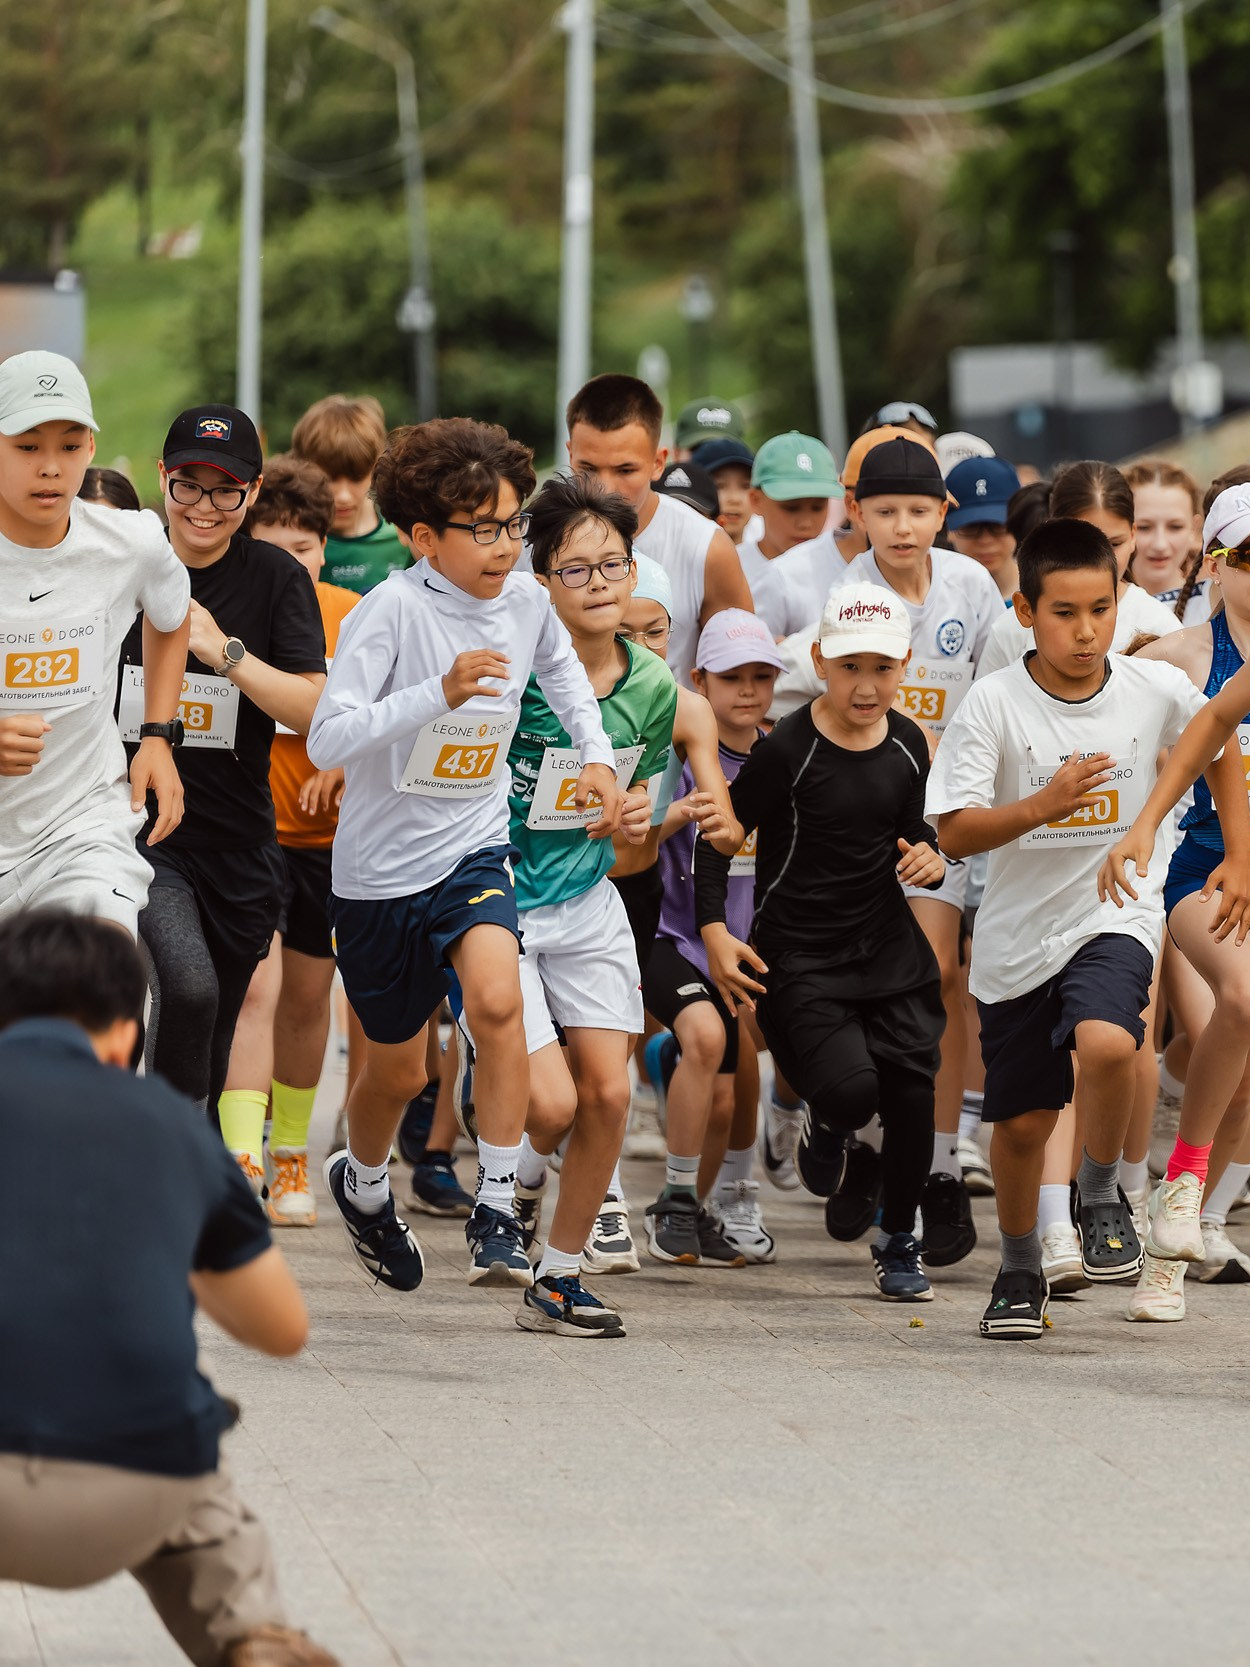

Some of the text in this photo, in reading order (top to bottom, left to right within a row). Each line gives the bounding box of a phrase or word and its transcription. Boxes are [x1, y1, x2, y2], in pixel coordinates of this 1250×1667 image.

[0, 633, 35, 644] EONE
[12, 653, 72, 683] 282
[0, 685, 92, 700] АГОТВОРИТЕЛЬНЫЙ ЗАБЕГ
[194, 684, 229, 698] D'ORO
[177, 704, 205, 727] 48
[432, 723, 474, 737] LEONE
[442, 747, 494, 775] 437
[414, 778, 484, 790] БЛАГОТВОРИТЕЛЬНЫЙ
[1032, 827, 1111, 840] БЛАГОТВОРИТЕЛЬНЫЙ
